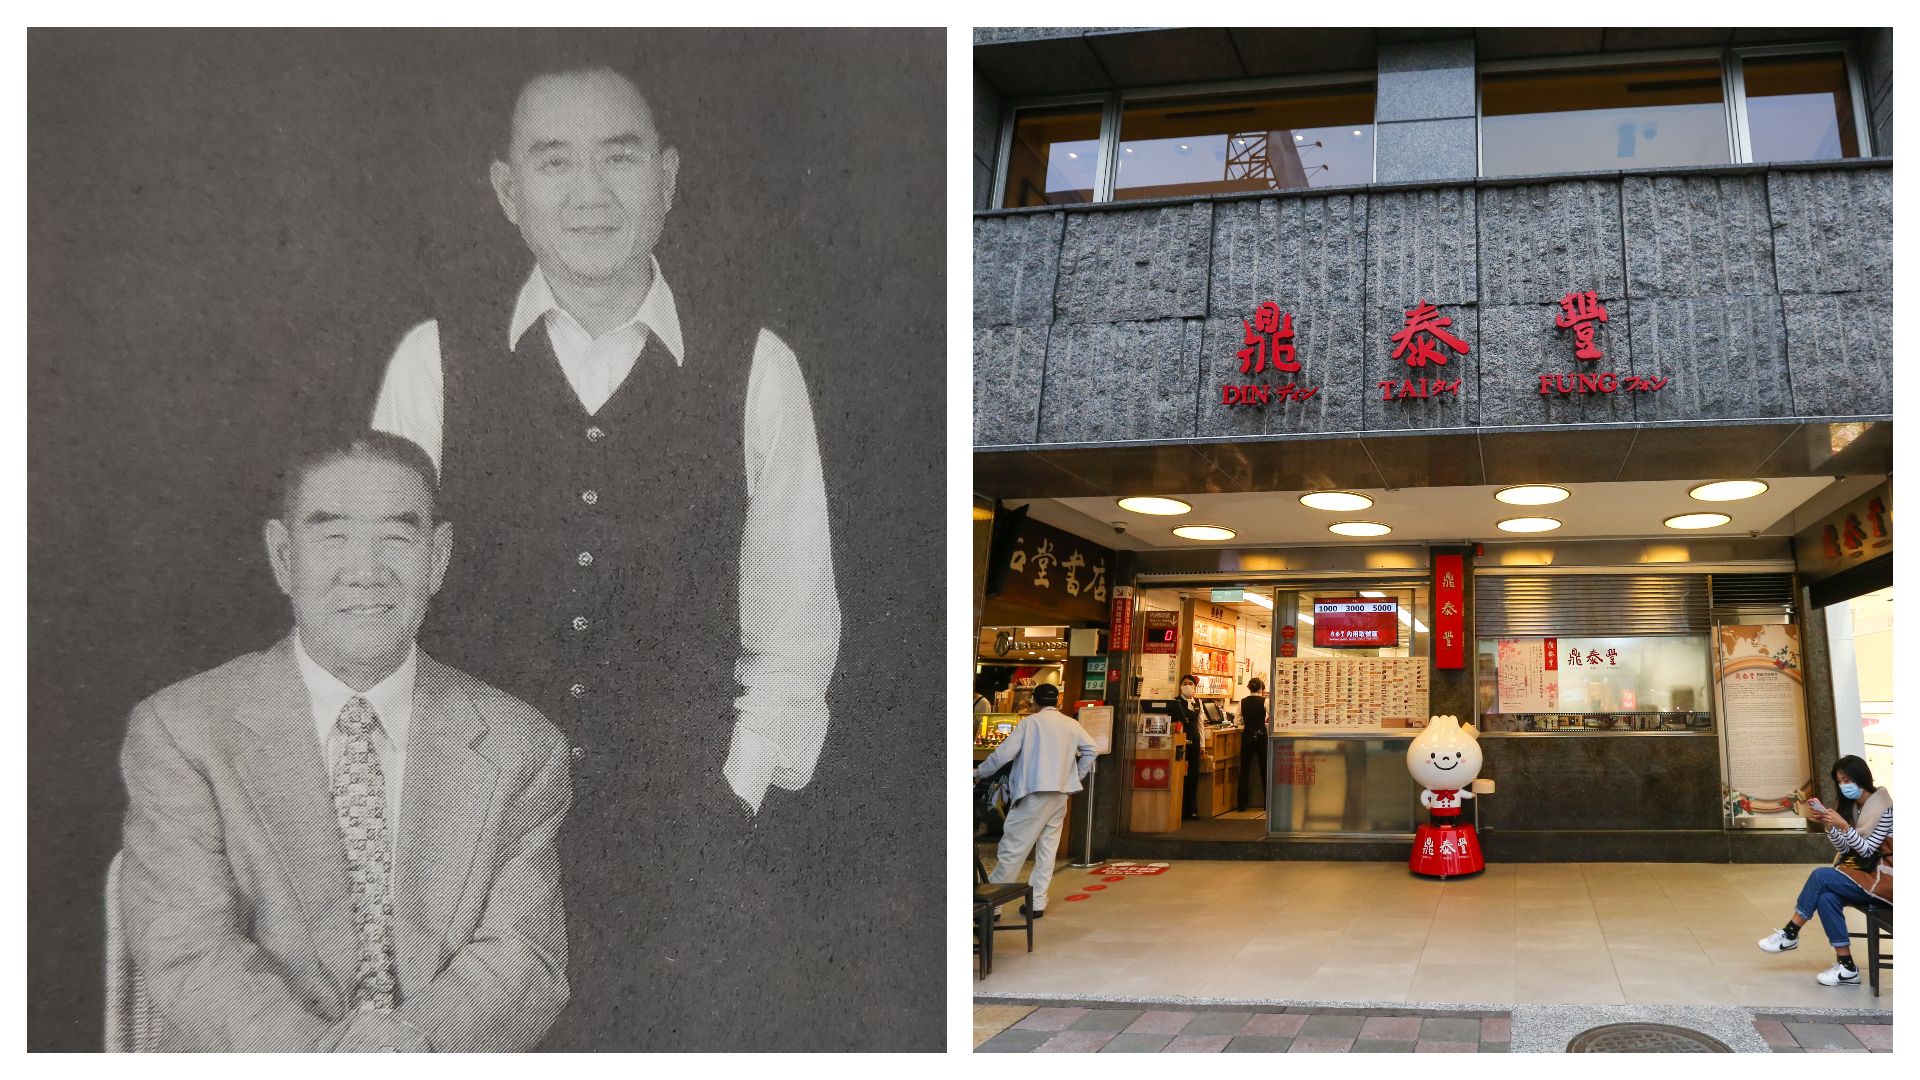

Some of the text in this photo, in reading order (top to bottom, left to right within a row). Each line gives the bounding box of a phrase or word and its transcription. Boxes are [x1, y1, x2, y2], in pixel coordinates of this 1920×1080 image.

[1221, 373, 1668, 404] DIN ディン TAI タイ FUNG フォン
[1372, 604, 1392, 612] 5000
[1164, 630, 1174, 641] 0
[1567, 647, 1618, 666] 鼎泰豐
[1088, 663, 1106, 671] 192
[1087, 681, 1104, 689] 194
[1422, 836, 1468, 856] 鼎泰豐
